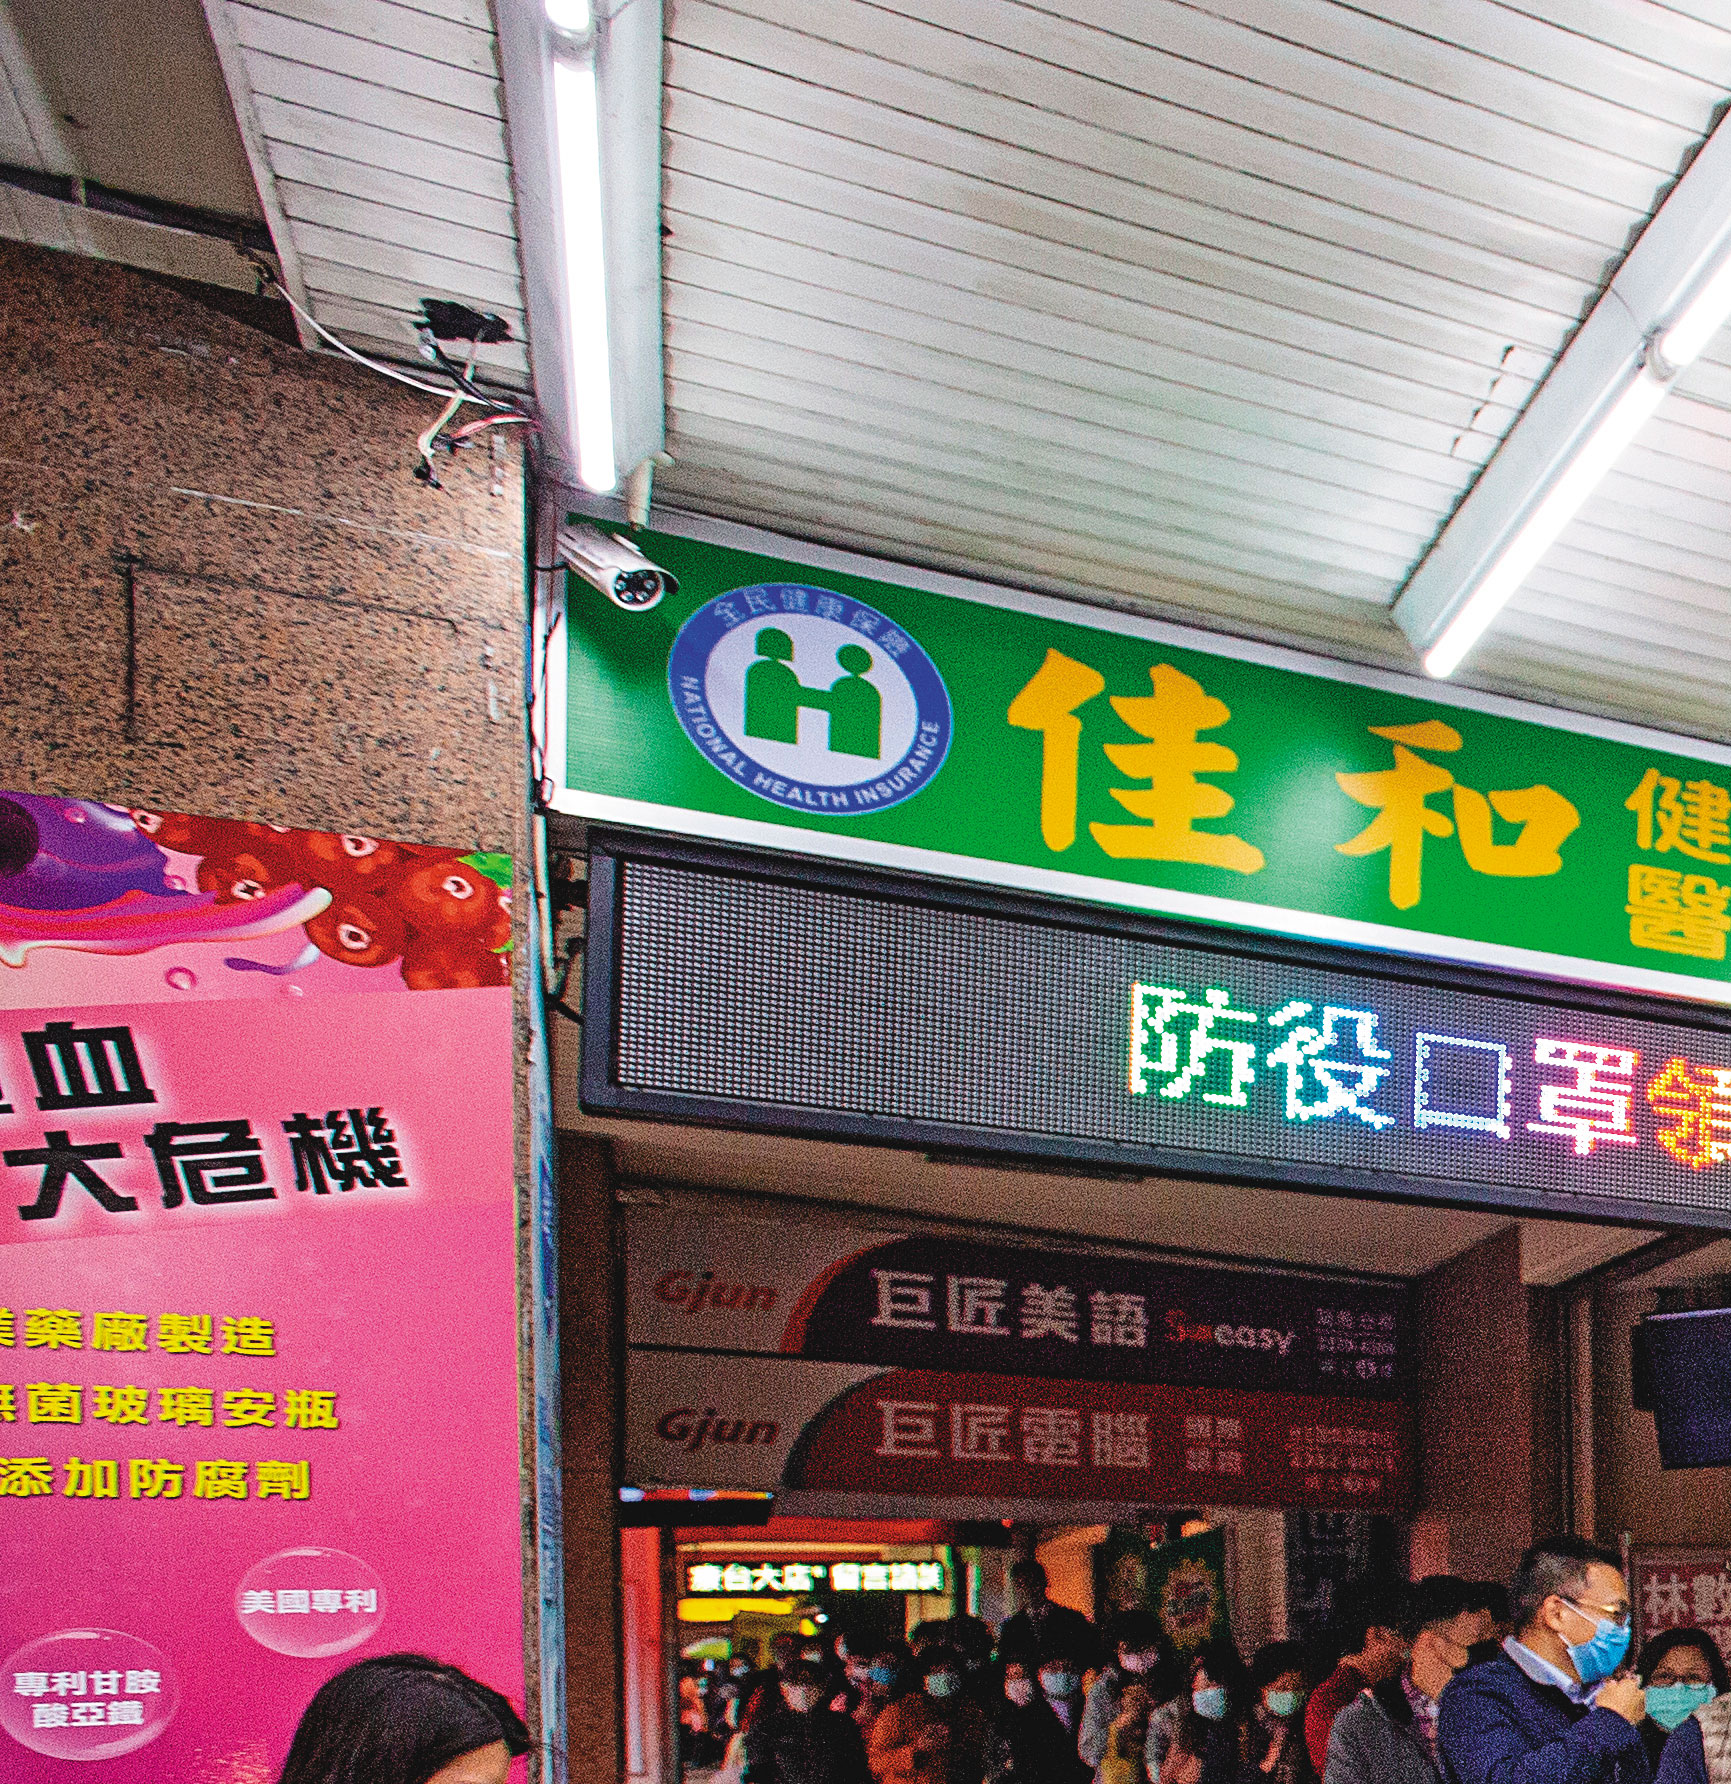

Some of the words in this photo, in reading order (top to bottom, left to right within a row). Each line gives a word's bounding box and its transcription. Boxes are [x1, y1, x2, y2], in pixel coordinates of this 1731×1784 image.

[681, 675, 748, 777] NATIONAL
[754, 772, 850, 807] HEALTH
[854, 720, 940, 805] INSURANCE
[1008, 648, 1580, 911] 佳和
[0, 1021, 158, 1114] 血
[2, 1106, 409, 1222] 大危機
[0, 1306, 277, 1357] 藥廠製造
[871, 1268, 1148, 1349] 巨匠美語
[0, 1382, 339, 1430] 菌玻璃安瓶
[655, 1407, 780, 1451] Gjun
[875, 1399, 1151, 1469] 巨匠電腦
[0, 1456, 311, 1501] 添加防腐劑
[242, 1588, 377, 1615] 美國專利
[13, 1669, 161, 1698] 專利甘胺
[32, 1700, 144, 1729] 酸亞鐵
